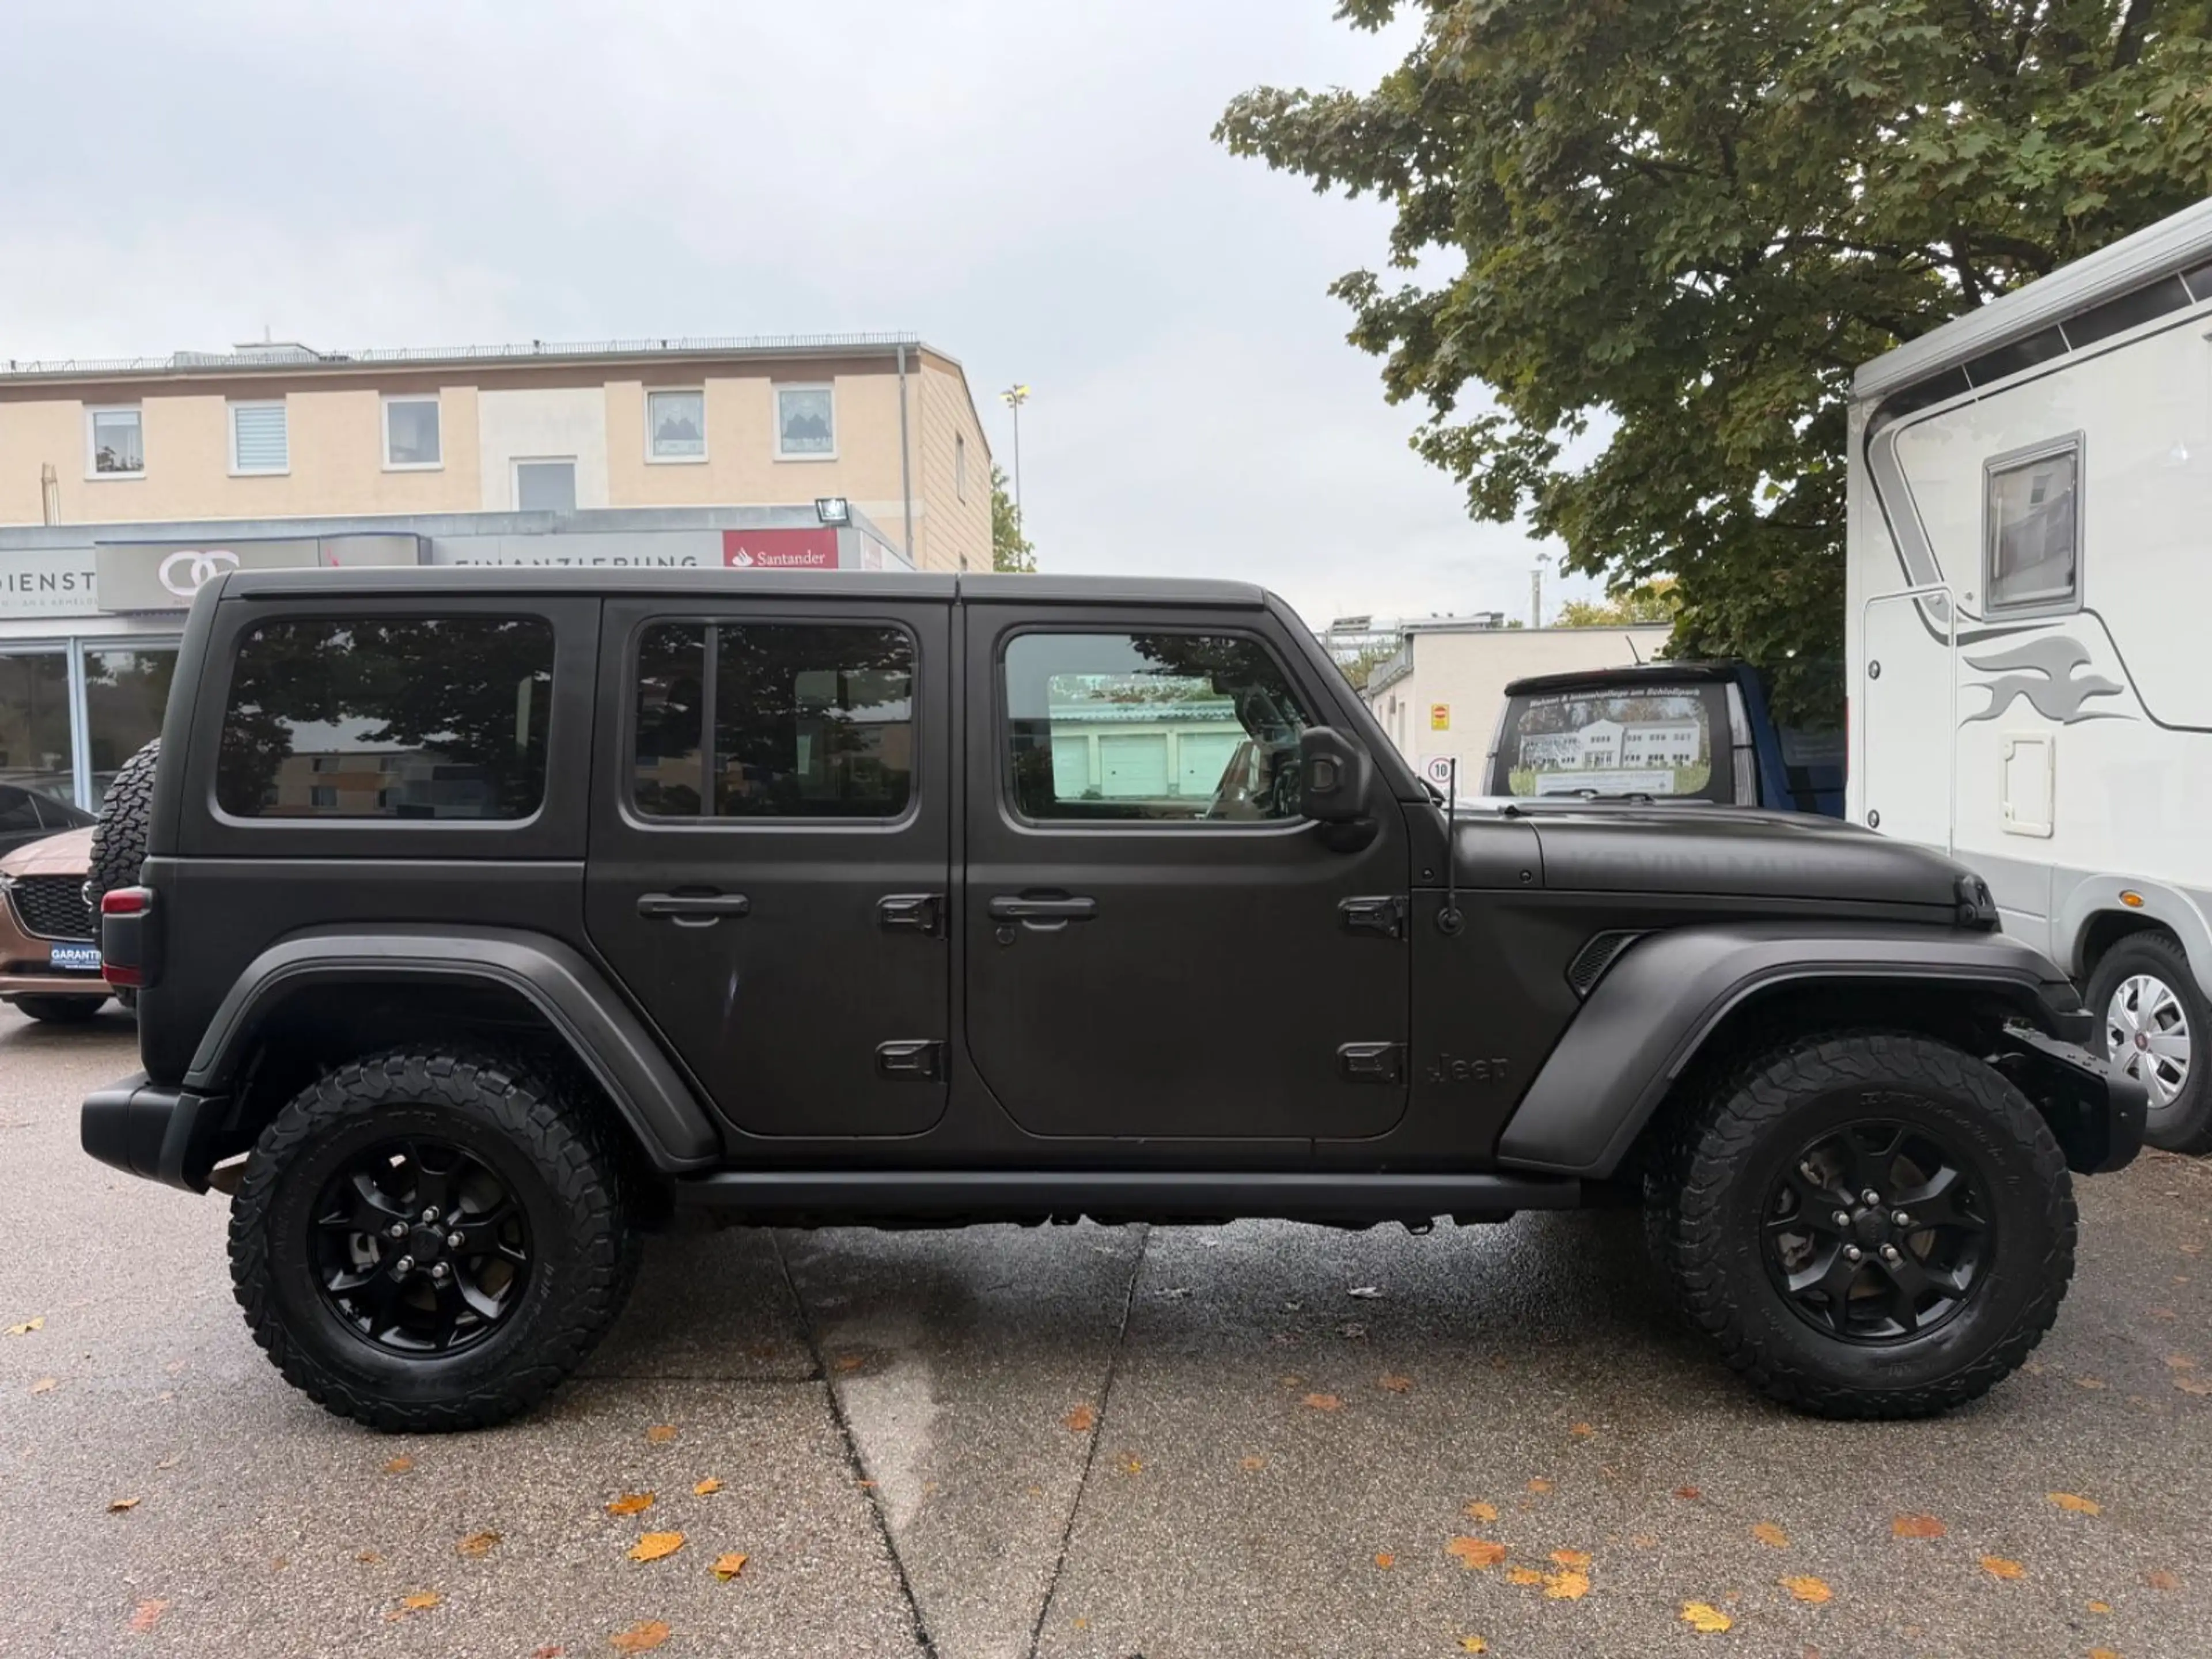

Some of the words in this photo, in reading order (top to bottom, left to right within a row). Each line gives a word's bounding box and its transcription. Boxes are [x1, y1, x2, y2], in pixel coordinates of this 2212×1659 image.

[757, 549, 825, 566] Santander
[0, 572, 96, 592] IENST
[1435, 763, 1448, 778] 10
